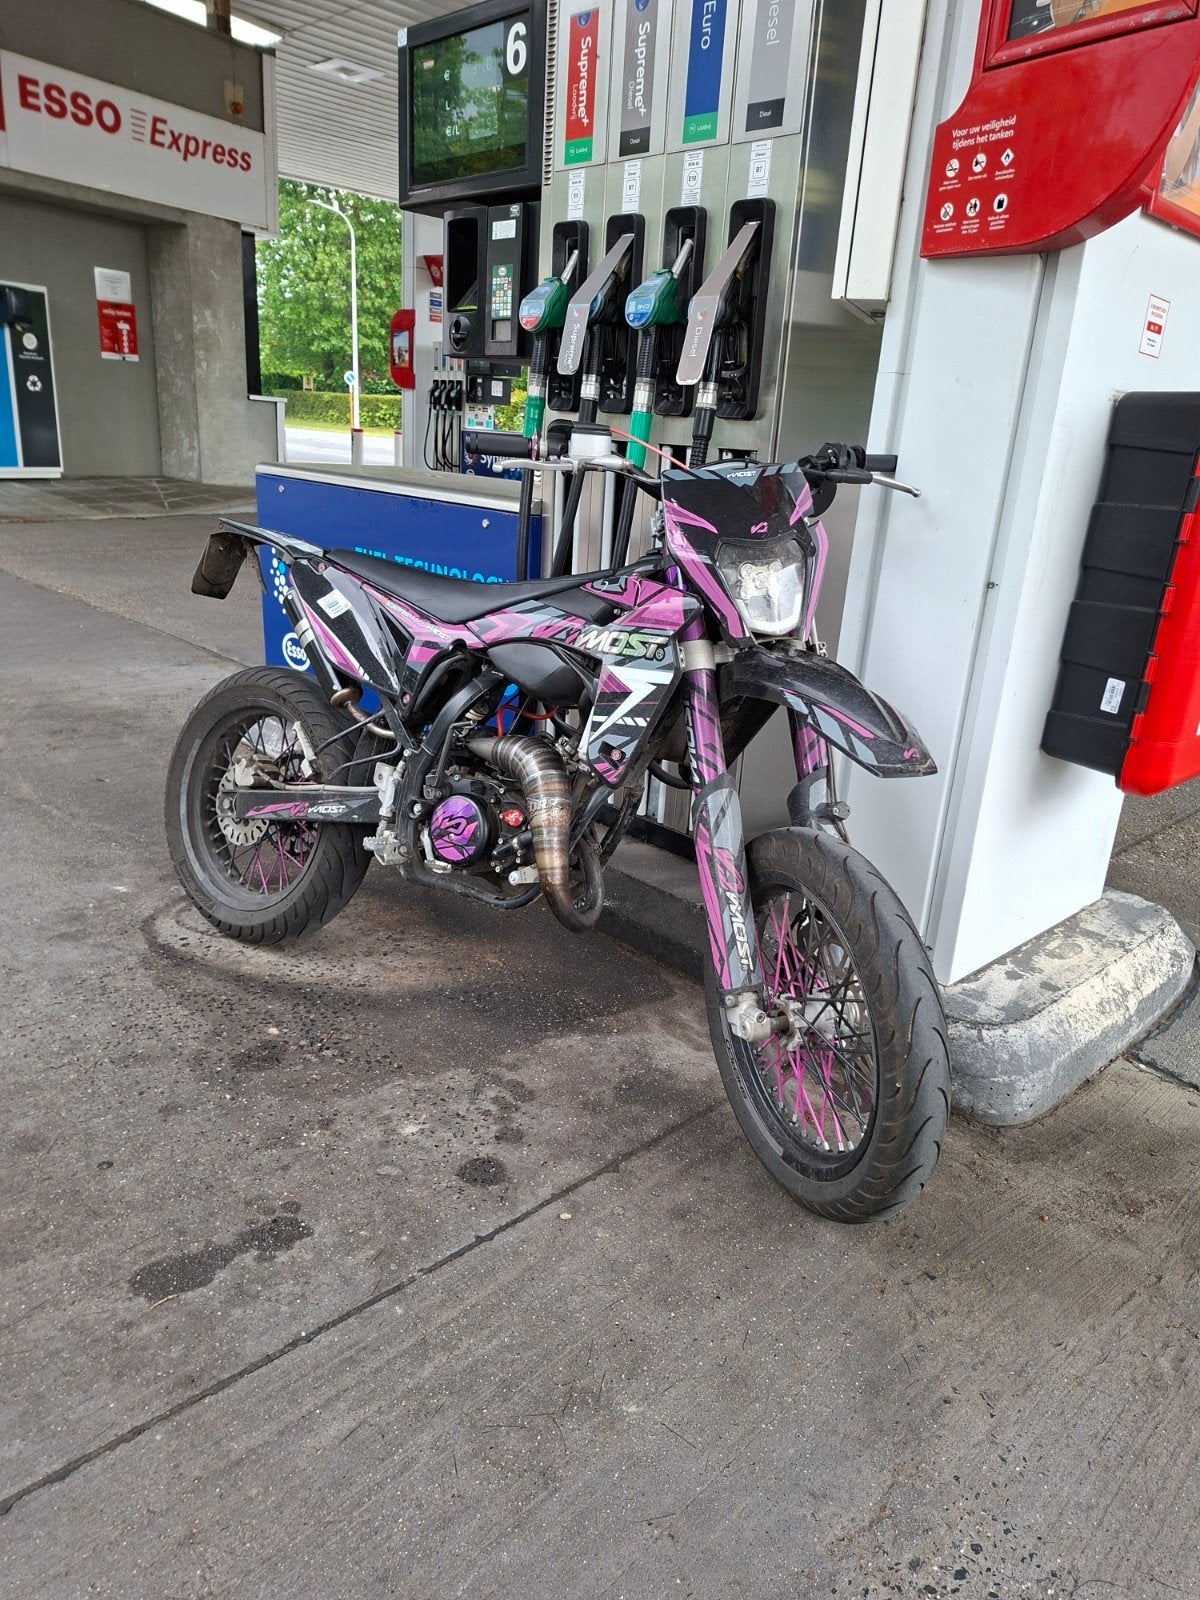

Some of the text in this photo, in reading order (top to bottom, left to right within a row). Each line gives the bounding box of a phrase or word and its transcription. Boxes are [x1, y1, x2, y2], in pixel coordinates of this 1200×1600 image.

[701, 0, 717, 50] Euro
[766, 0, 780, 45] iesel
[506, 21, 527, 75] 6
[627, 80, 636, 110] Diesel
[18, 74, 252, 172] ESSO Express
[759, 109, 772, 118] Diesel
[952, 114, 1017, 138] Voor uw veiligheid
[952, 129, 1014, 151] tijdens het tanken
[690, 326, 703, 357] Diesel
[726, 470, 757, 479] MOST
[307, 804, 346, 815] MOST
